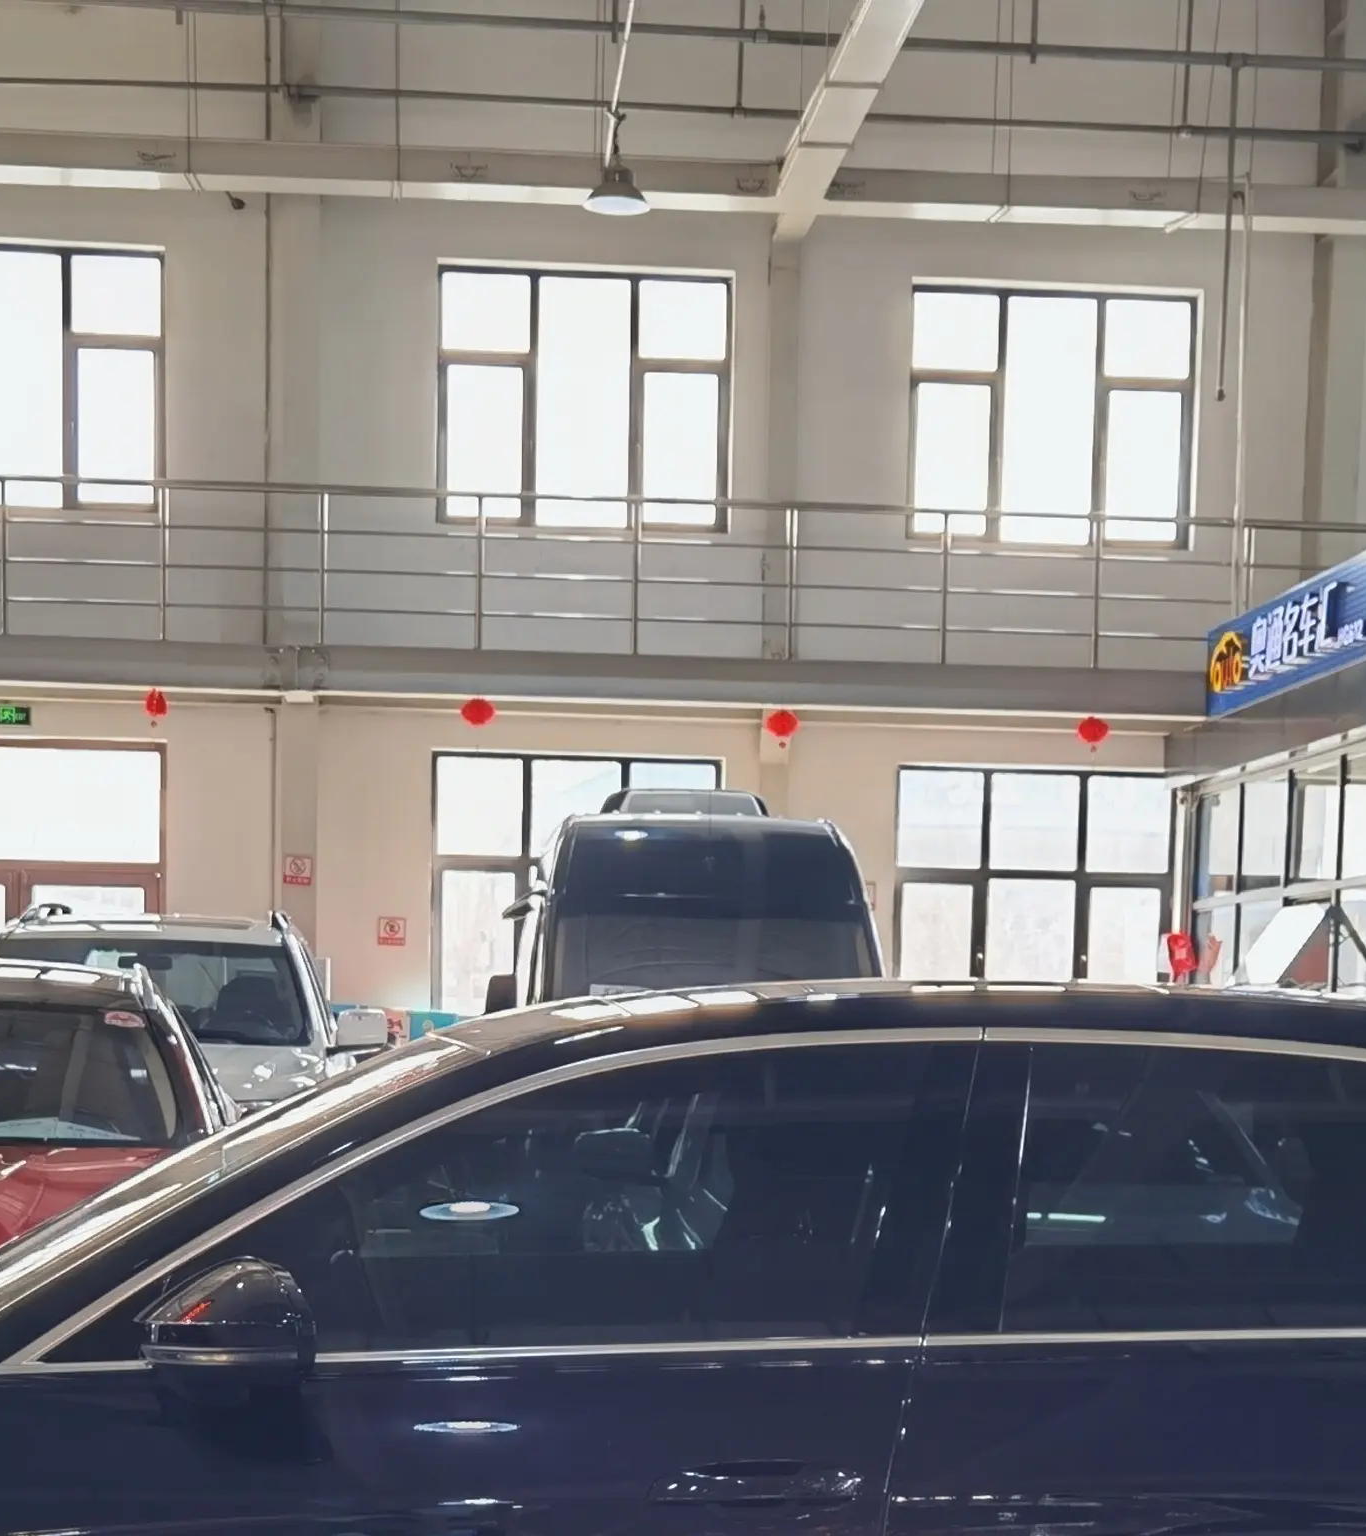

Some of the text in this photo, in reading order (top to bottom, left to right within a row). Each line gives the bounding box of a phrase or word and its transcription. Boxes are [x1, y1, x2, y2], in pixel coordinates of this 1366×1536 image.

[1248, 581, 1338, 678] 奥通名车汇
